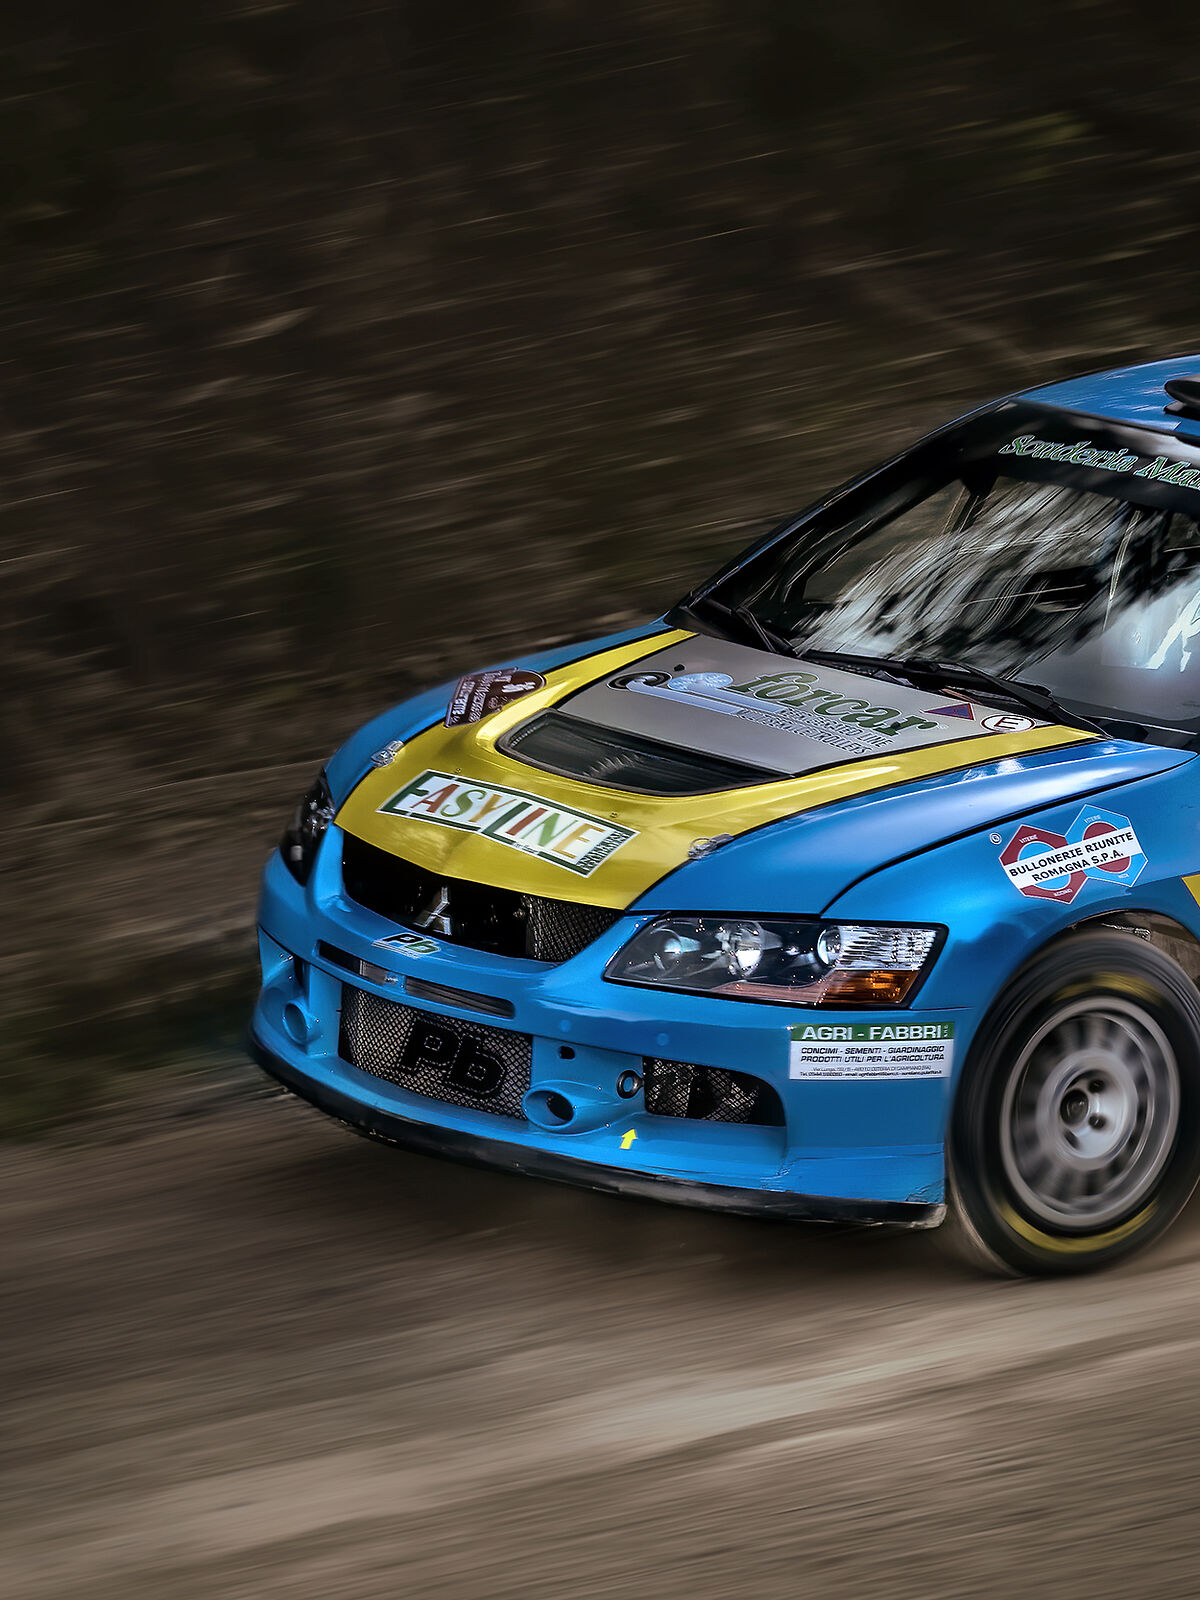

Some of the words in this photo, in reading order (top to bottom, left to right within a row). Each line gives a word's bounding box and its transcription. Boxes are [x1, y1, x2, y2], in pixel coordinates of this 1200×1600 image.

[732, 671, 939, 737] forcar
[993, 716, 1024, 730] E
[1009, 846, 1084, 877] BULLONERIE
[1084, 831, 1134, 854] RIUNITE
[1031, 858, 1091, 882] ROMAGNA
[1092, 848, 1124, 865] S.P.A.
[378, 932, 442, 955] Pb
[801, 1026, 853, 1040] AGRI
[869, 1024, 942, 1040] FABBRI
[400, 1016, 505, 1094] Pb
[801, 1047, 838, 1055] CONCIMI
[888, 1045, 945, 1054] GIARDINAGGIO
[884, 1054, 945, 1062] L'AGRICOLTURA
